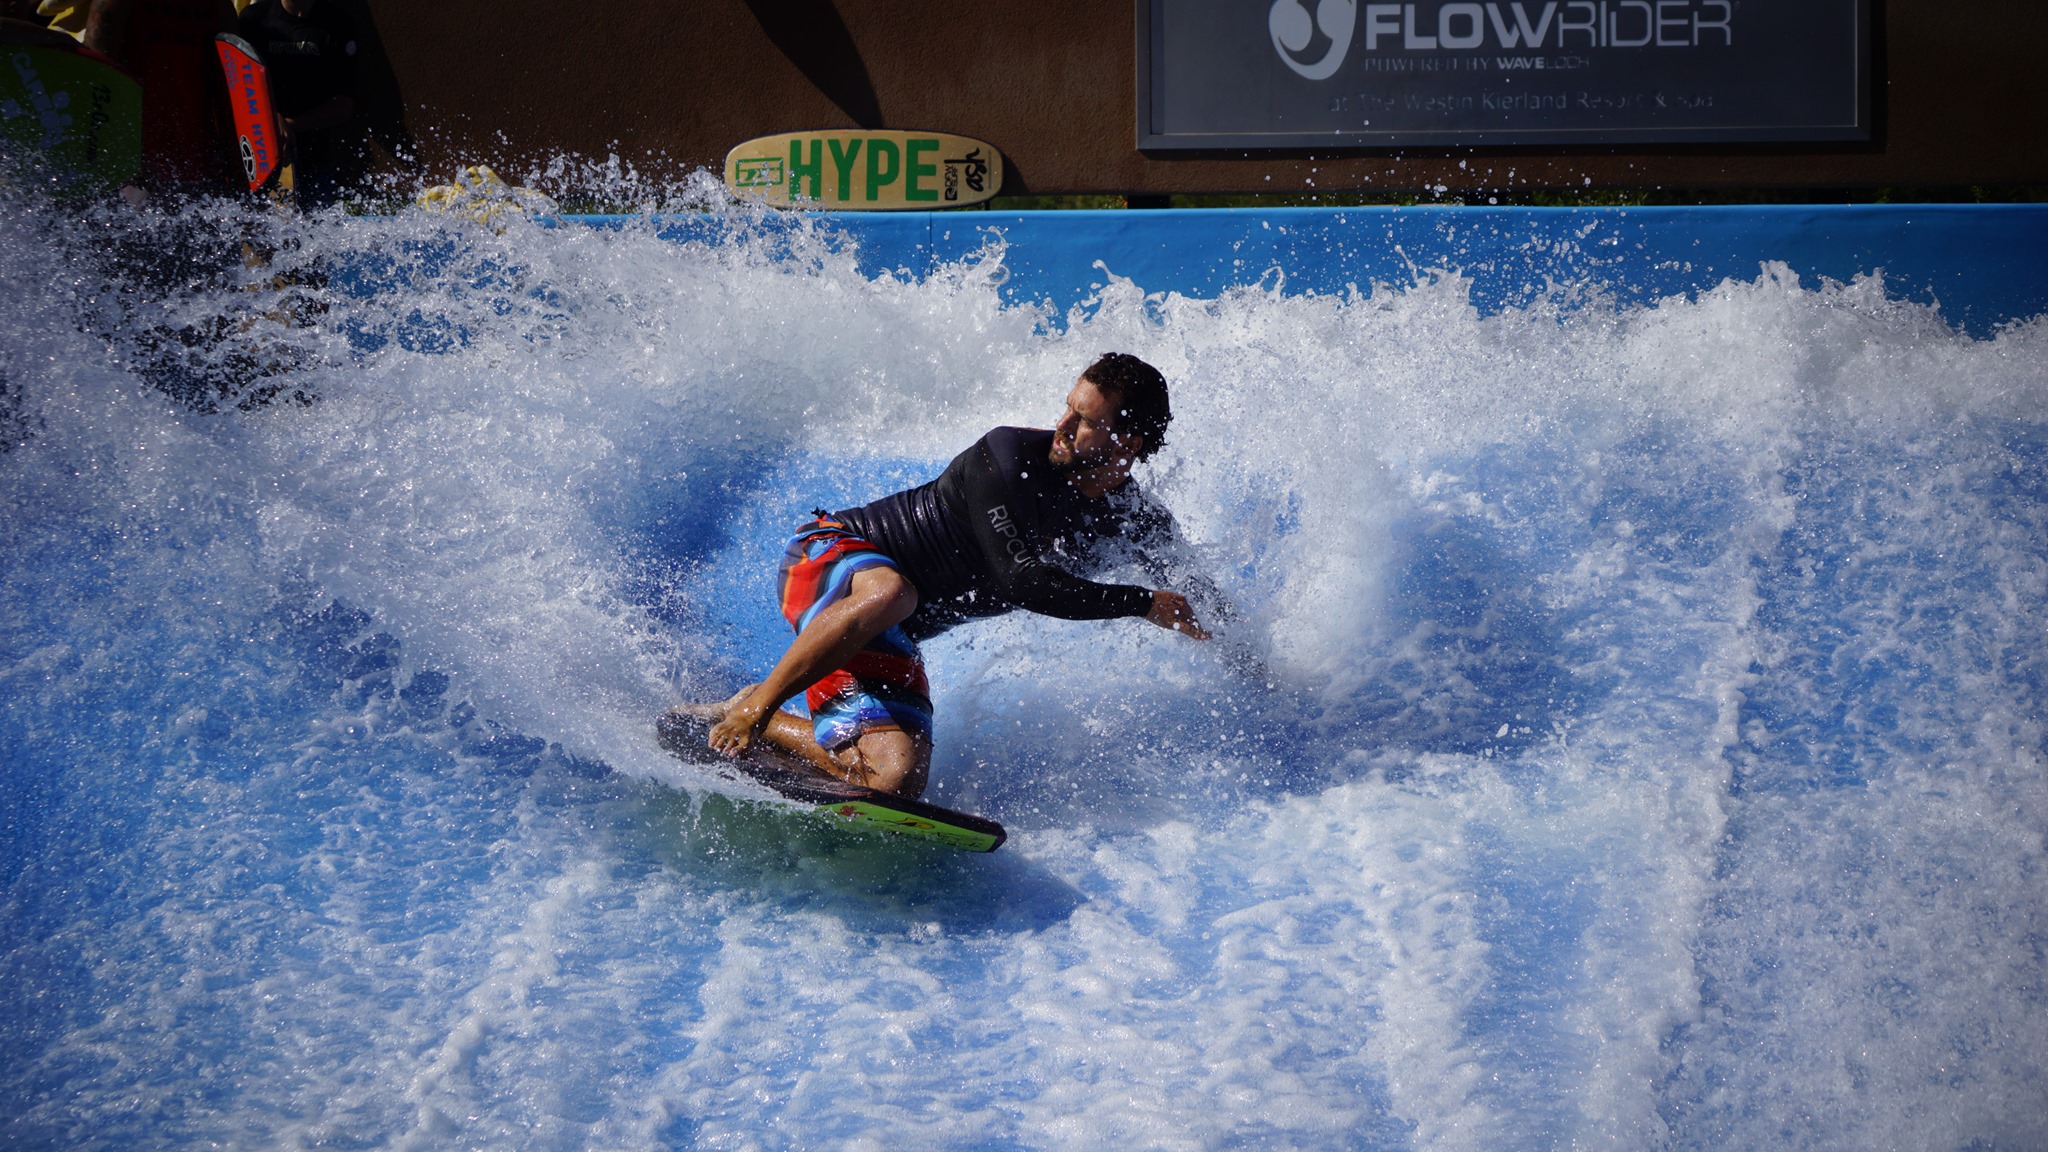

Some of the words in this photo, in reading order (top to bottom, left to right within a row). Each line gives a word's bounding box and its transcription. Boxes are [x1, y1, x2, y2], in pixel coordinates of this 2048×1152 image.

[1365, 0, 1732, 50] FLOWRIDER
[1364, 57, 1458, 71] POWERED
[1466, 57, 1490, 71] BY
[242, 62, 259, 115] TEAM
[252, 123, 271, 175] HYPE
[1405, 94, 1473, 111] Westin
[1482, 92, 1567, 110] Kierland
[789, 138, 940, 201] HYPE
